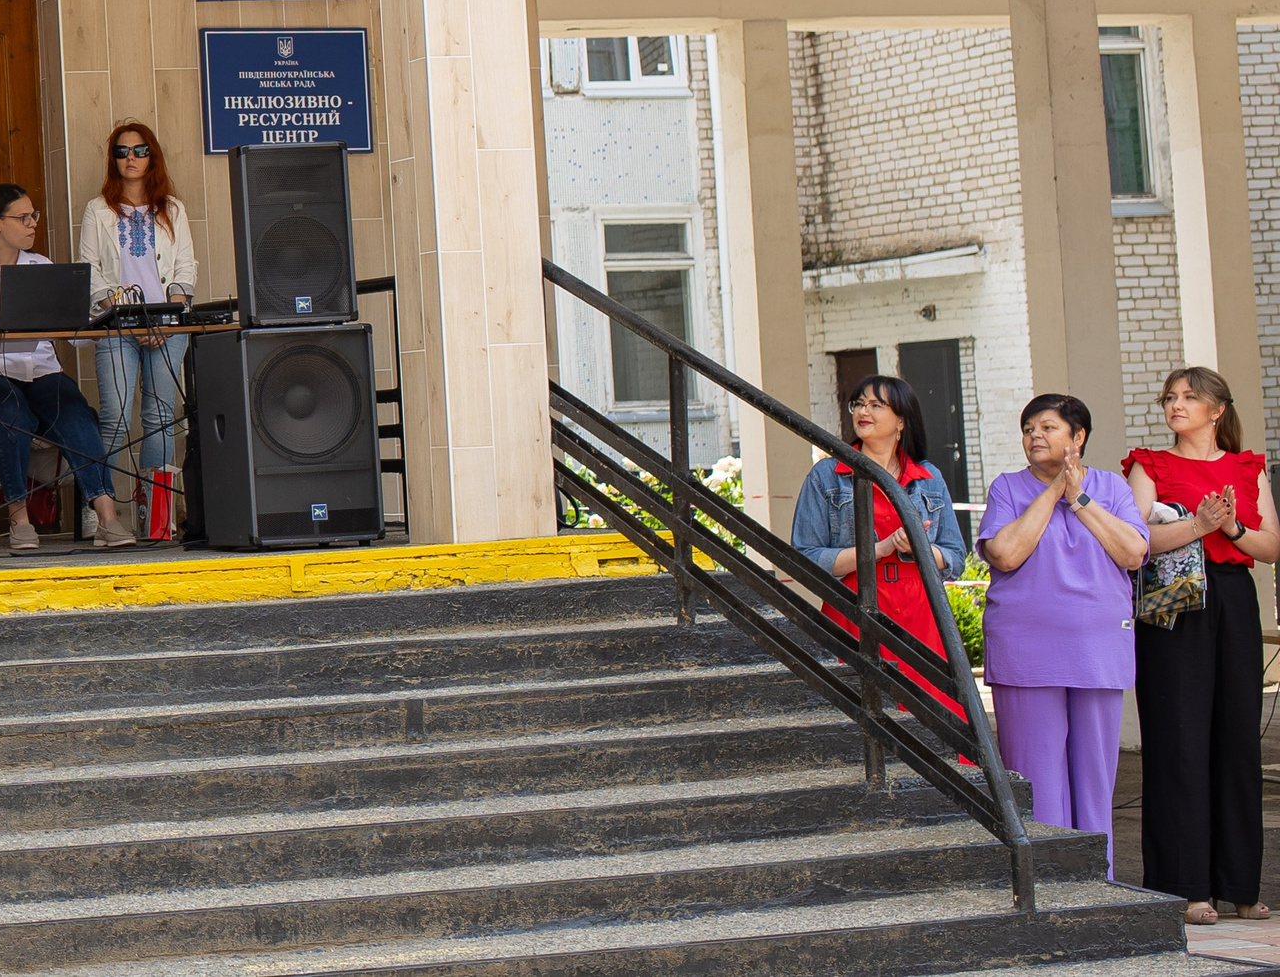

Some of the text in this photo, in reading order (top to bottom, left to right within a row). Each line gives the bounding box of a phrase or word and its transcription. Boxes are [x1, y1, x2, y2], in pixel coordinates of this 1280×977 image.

[238, 70, 335, 80] ПІВДЕННОУКРАЇНСЬКА
[259, 80, 316, 89] МІСЬКА РАДА
[224, 95, 342, 110] ІНКЛЮЗИВНО
[238, 110, 341, 127] РЕСУРСНИЙ
[261, 129, 319, 144] ЦЕНТР
